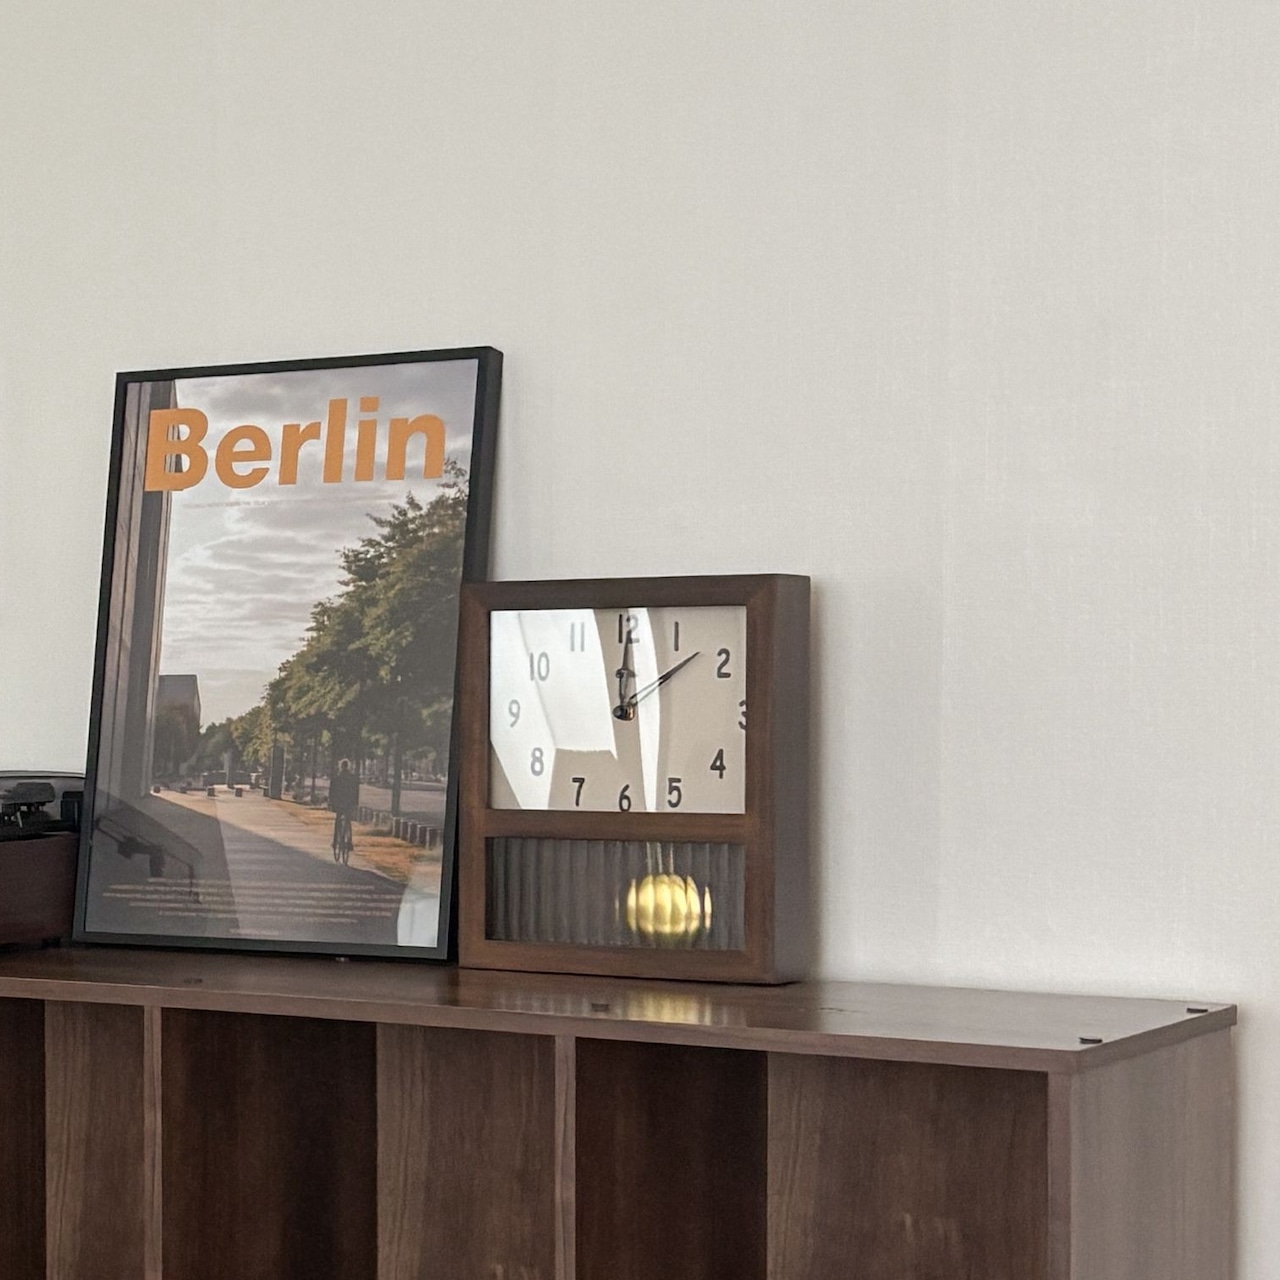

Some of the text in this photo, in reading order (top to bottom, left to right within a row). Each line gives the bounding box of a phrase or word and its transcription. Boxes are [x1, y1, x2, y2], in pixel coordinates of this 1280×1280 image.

[145, 396, 445, 491] Berlin
[570, 622, 584, 652] 11
[618, 614, 640, 643] 12
[674, 621, 679, 651] 1
[529, 652, 550, 681] 10
[717, 648, 731, 678] 2
[509, 699, 521, 727] 9
[531, 747, 544, 776] 8
[710, 749, 726, 779] 4
[572, 777, 585, 806] 7
[620, 784, 631, 811] 6
[668, 778, 682, 808] 5
